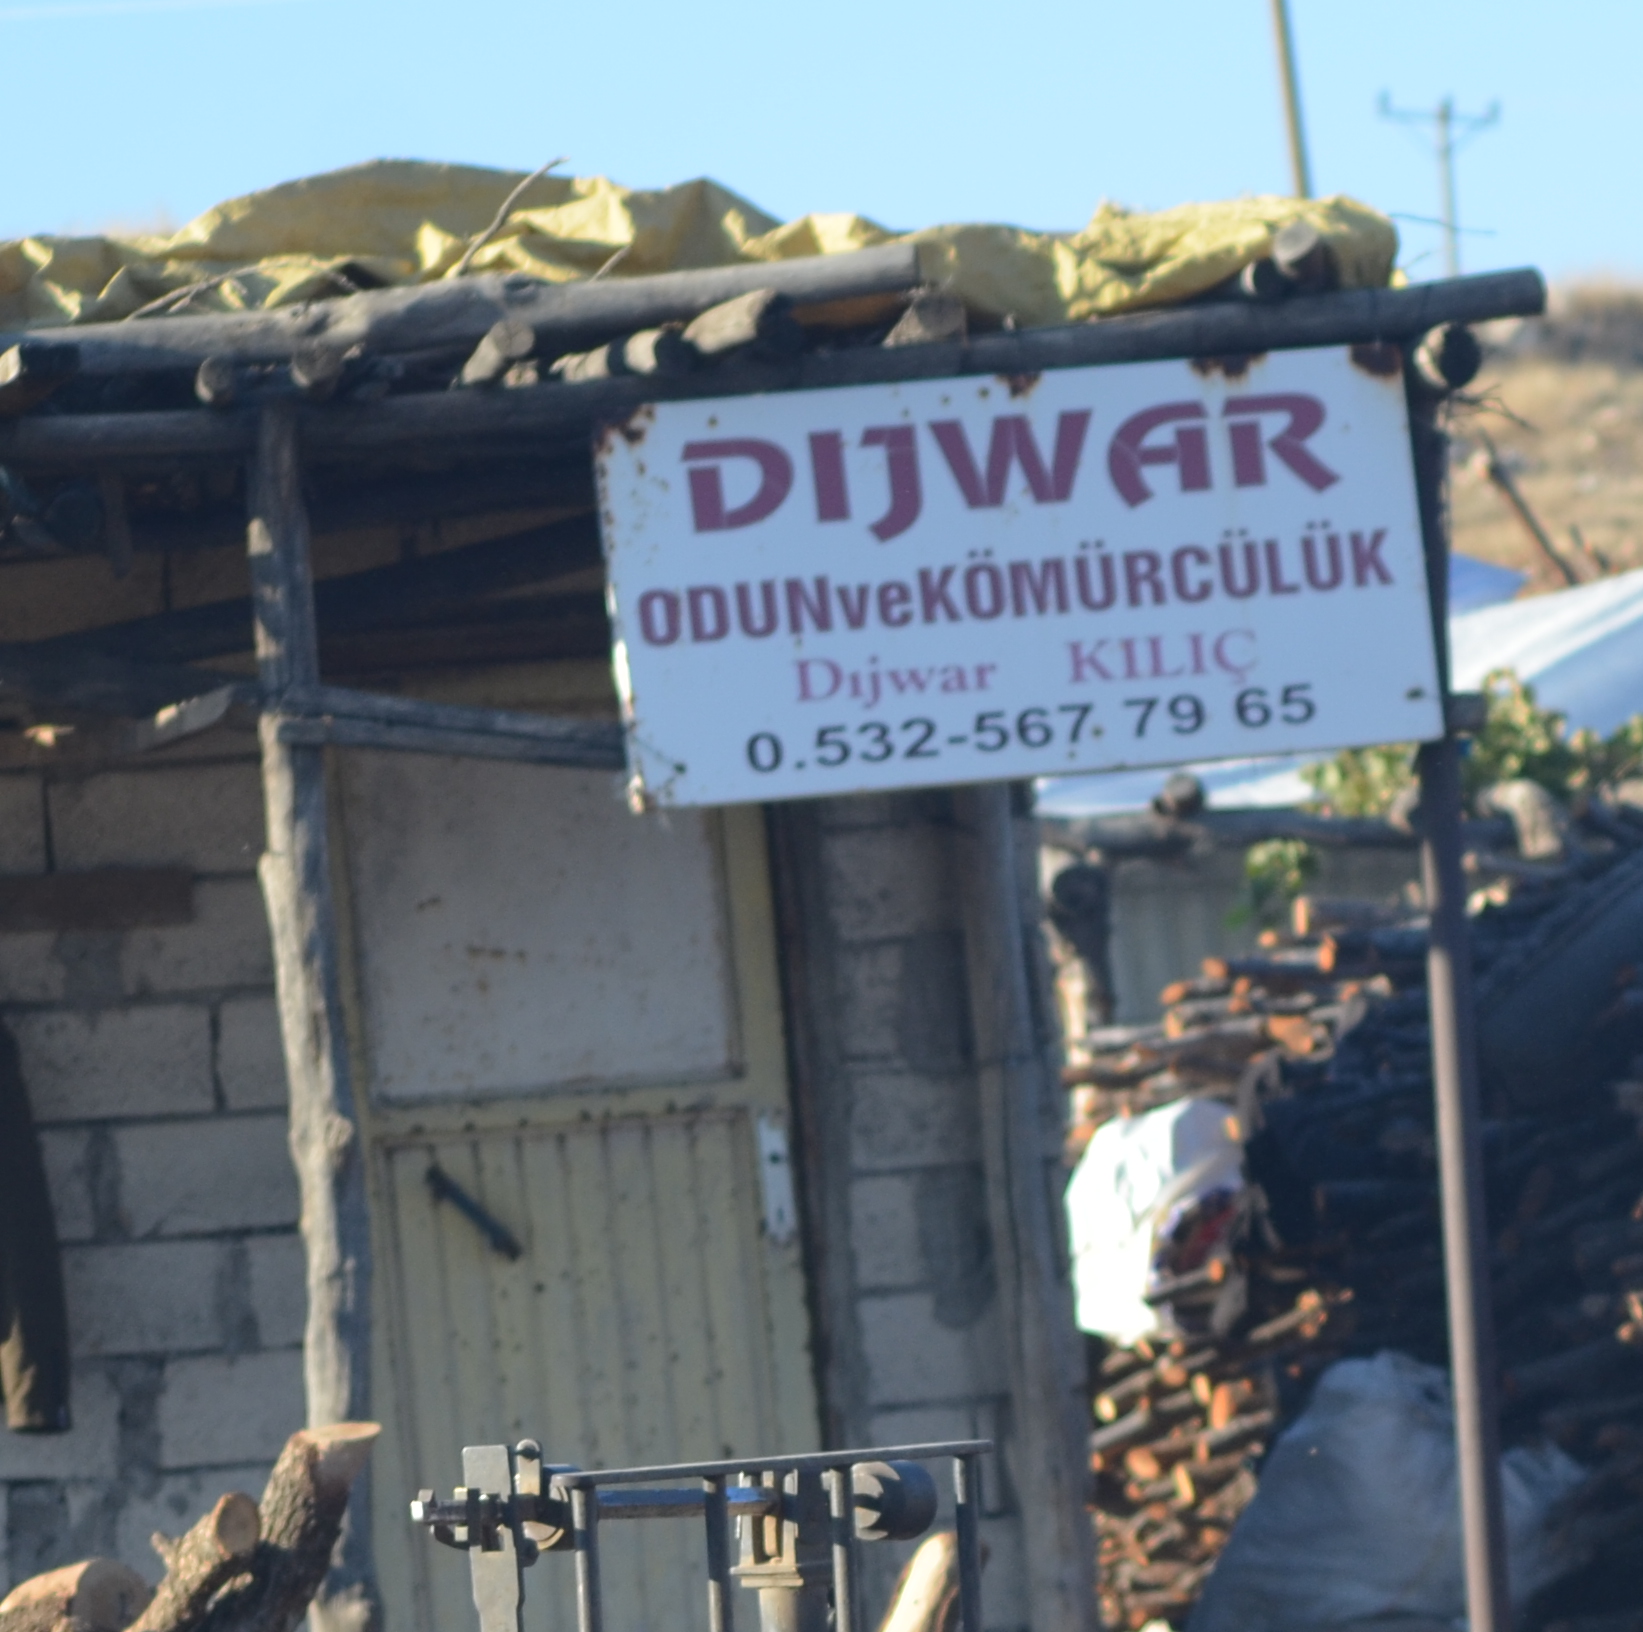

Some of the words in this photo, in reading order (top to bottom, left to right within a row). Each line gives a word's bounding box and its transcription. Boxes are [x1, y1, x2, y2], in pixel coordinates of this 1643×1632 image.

[680, 391, 1341, 542] DIJWAR
[637, 522, 1394, 647] ODUNveKÖMÜRCÜLÜK
[1066, 628, 1259, 687] KILIÇ
[1234, 683, 1316, 729] 65
